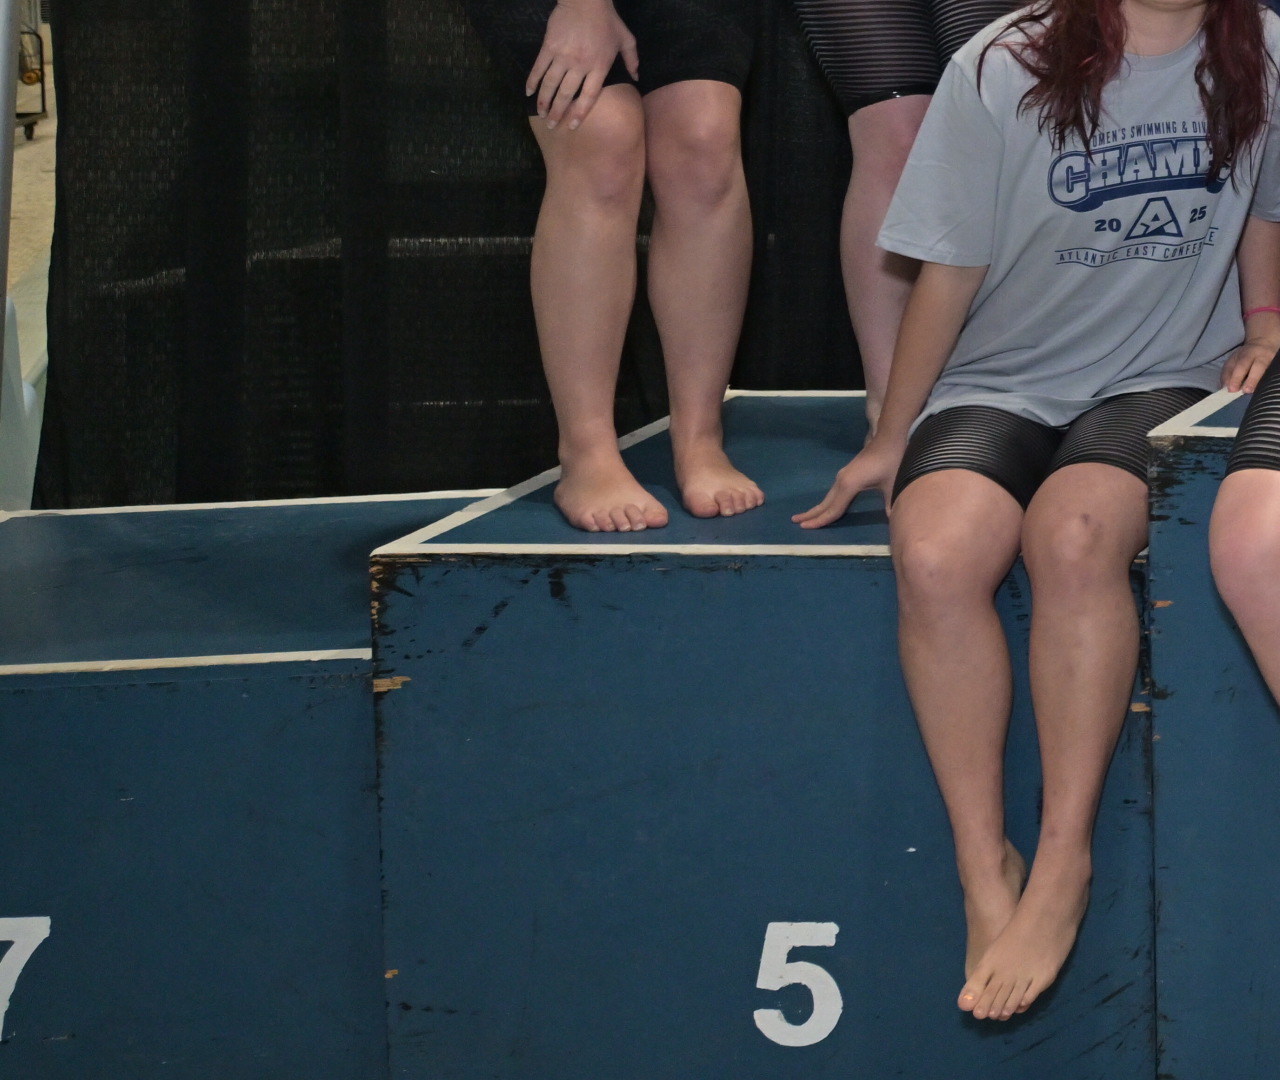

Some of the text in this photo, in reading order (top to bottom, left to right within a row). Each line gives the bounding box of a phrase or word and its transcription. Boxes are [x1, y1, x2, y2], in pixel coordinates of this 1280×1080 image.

[1130, 121, 1177, 141] SWIMMING
[1094, 207, 1206, 232] 20 25
[1125, 244, 1155, 259] EAST
[753, 922, 843, 1046] 5
